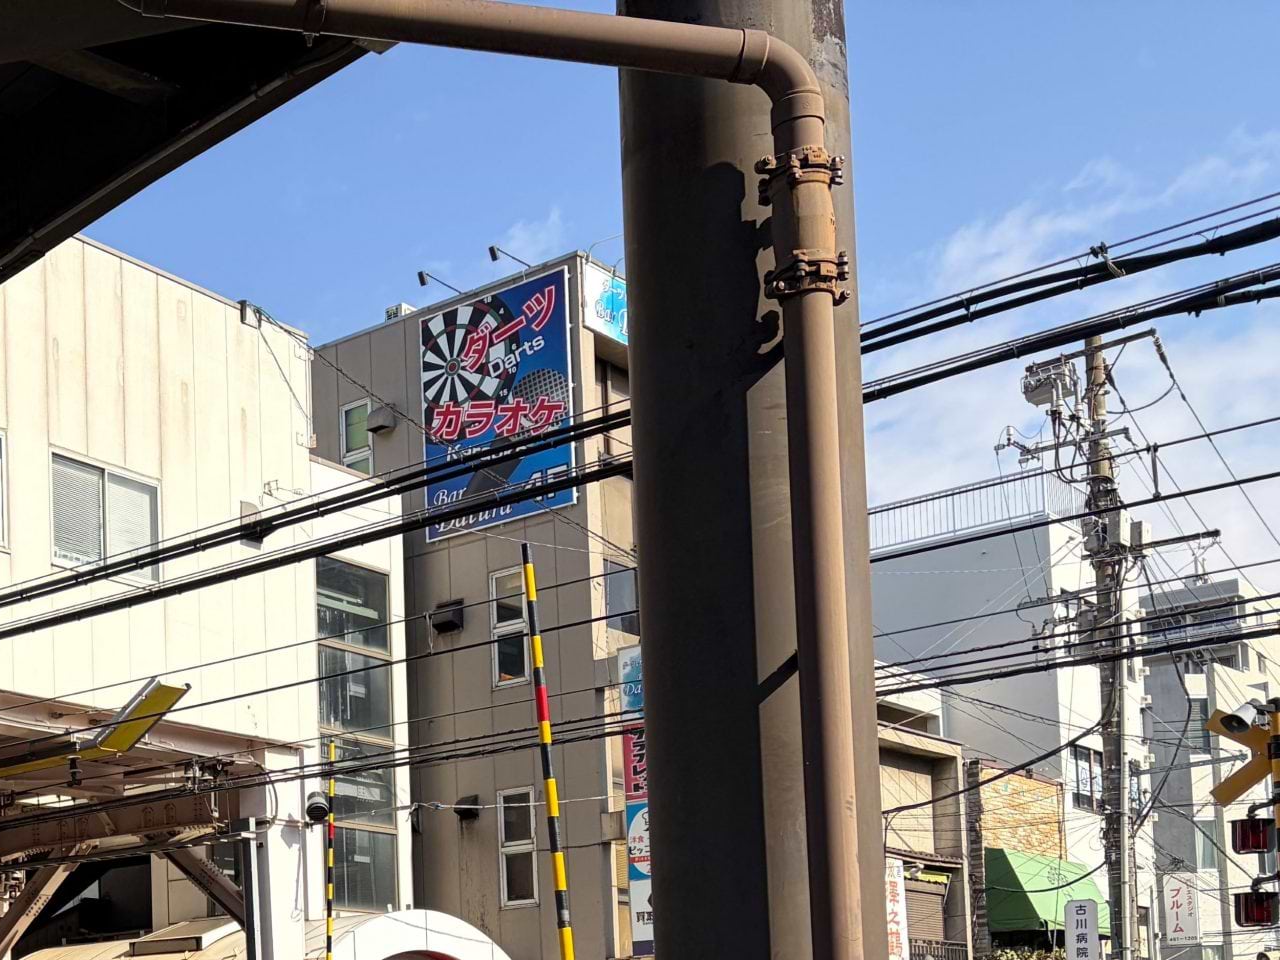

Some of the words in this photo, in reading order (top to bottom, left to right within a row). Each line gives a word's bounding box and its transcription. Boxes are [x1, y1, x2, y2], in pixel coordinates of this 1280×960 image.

[460, 285, 556, 372] ダーツ
[488, 335, 545, 378] Darts
[431, 396, 565, 439] カラオケ
[433, 487, 467, 505] Bar
[1074, 904, 1089, 958] 古川病院
